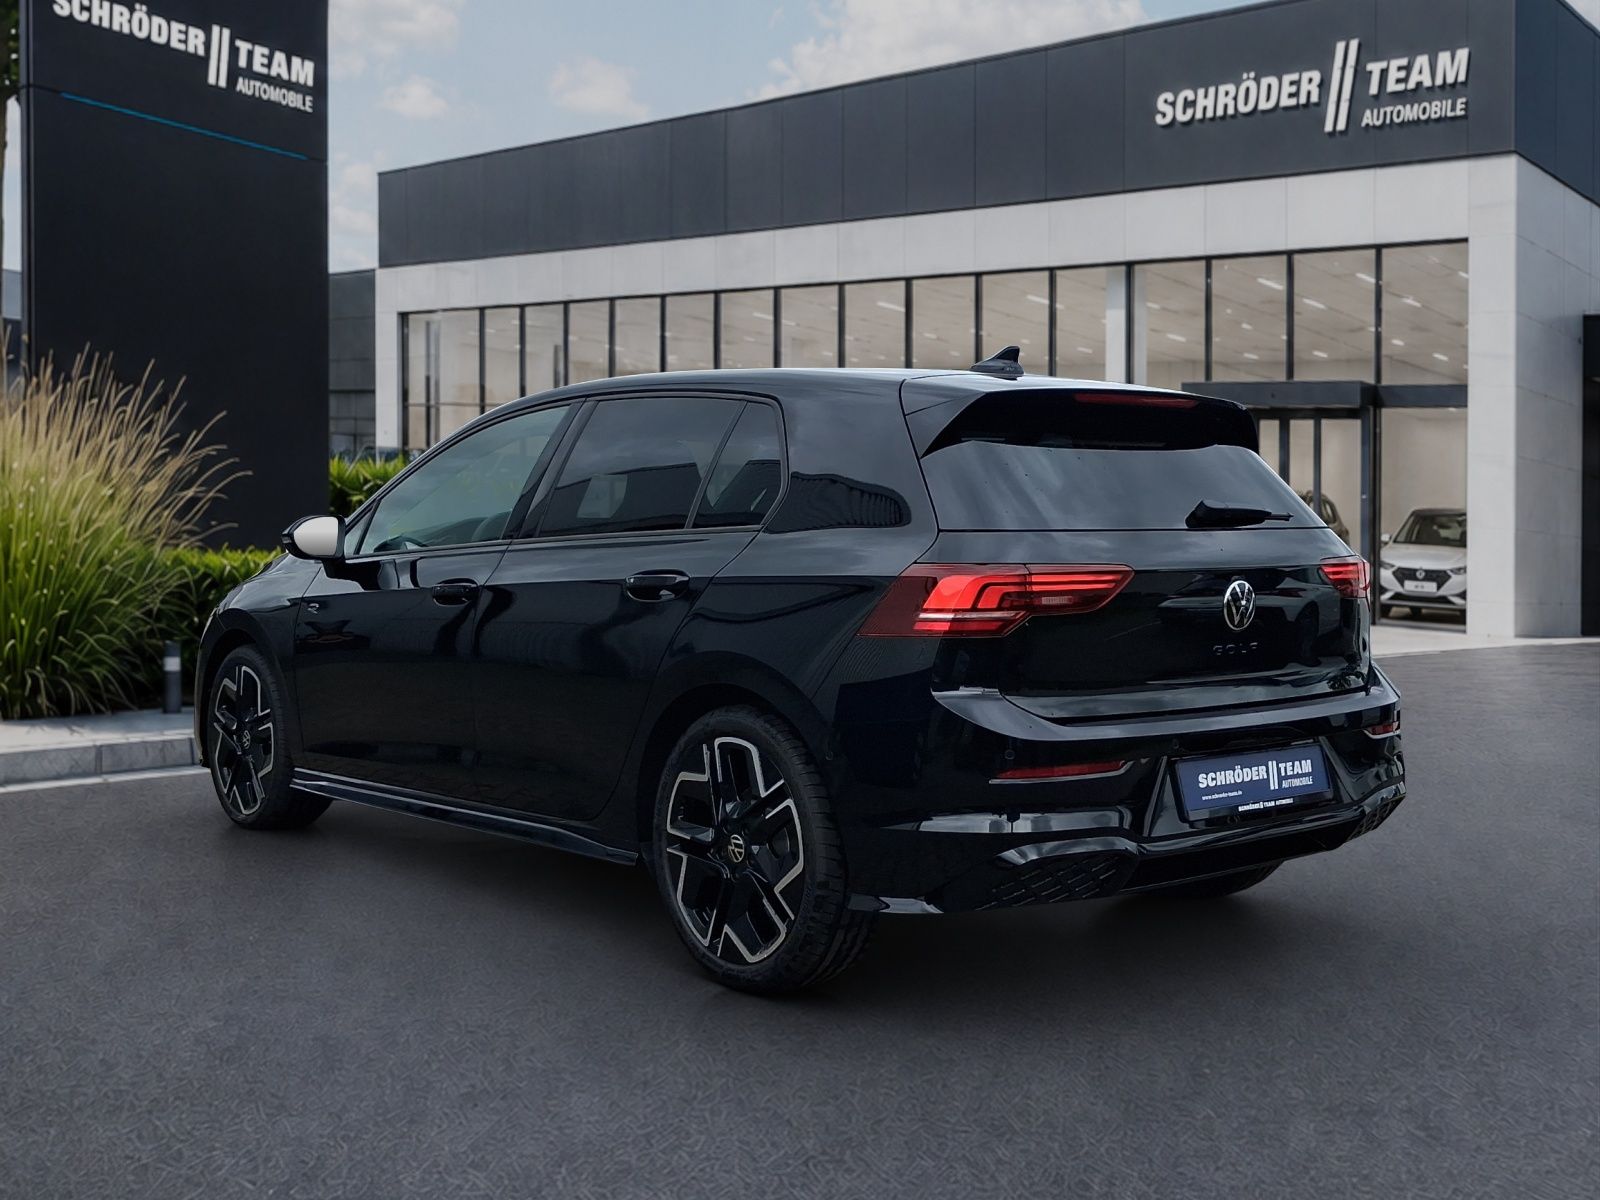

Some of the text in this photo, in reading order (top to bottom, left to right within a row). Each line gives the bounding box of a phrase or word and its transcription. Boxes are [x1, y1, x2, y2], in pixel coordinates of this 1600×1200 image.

[53, 0, 314, 87] SCHRÖDER TEAM
[236, 77, 313, 113] AUTOMOBILE
[1155, 47, 1470, 126] SCHRÖDER TEAM
[1361, 97, 1467, 127] AUTOMOBILE
[1198, 759, 1312, 788] SCHRÖDER TEAM
[1282, 776, 1313, 788] AUTOMOBILE
